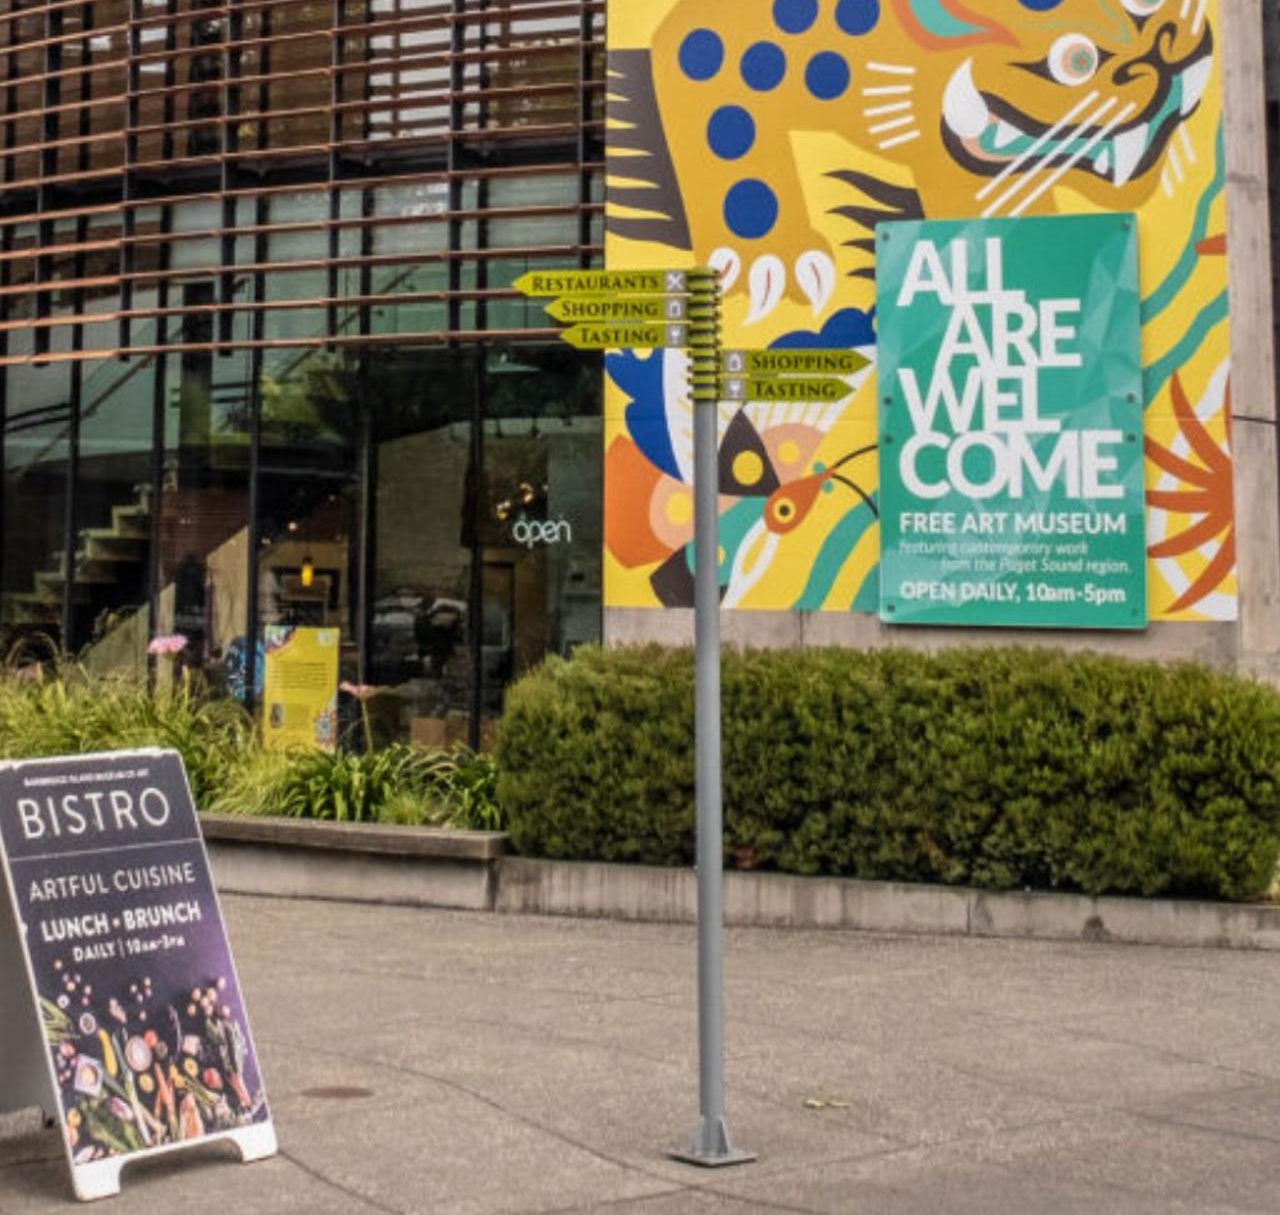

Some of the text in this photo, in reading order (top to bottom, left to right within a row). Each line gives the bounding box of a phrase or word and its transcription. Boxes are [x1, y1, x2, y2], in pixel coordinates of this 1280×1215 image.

[896, 237, 1025, 306] ALL
[532, 275, 658, 291] RESTAURANTS
[562, 301, 658, 317] SHOPPING
[581, 327, 658, 344] TASTING
[935, 298, 1083, 369] ARE
[752, 354, 853, 371] SHOPPING
[756, 383, 836, 398] TASTING
[897, 367, 1061, 434] WEL
[899, 429, 1125, 499] COME
[513, 519, 571, 549] open
[900, 513, 1126, 534] FREE ART MUSEUM
[975, 559, 995, 571] the
[1000, 558, 1037, 574] Puget
[1042, 558, 1083, 572] Sound
[900, 582, 956, 600] OPEN
[961, 582, 1020, 603] DAILY,
[17, 787, 170, 839] BISTRO
[29, 862, 196, 904] ARTFUL CUISINE
[40, 900, 202, 942] LUNCH BRUNCH
[72, 940, 116, 962] DAILY
